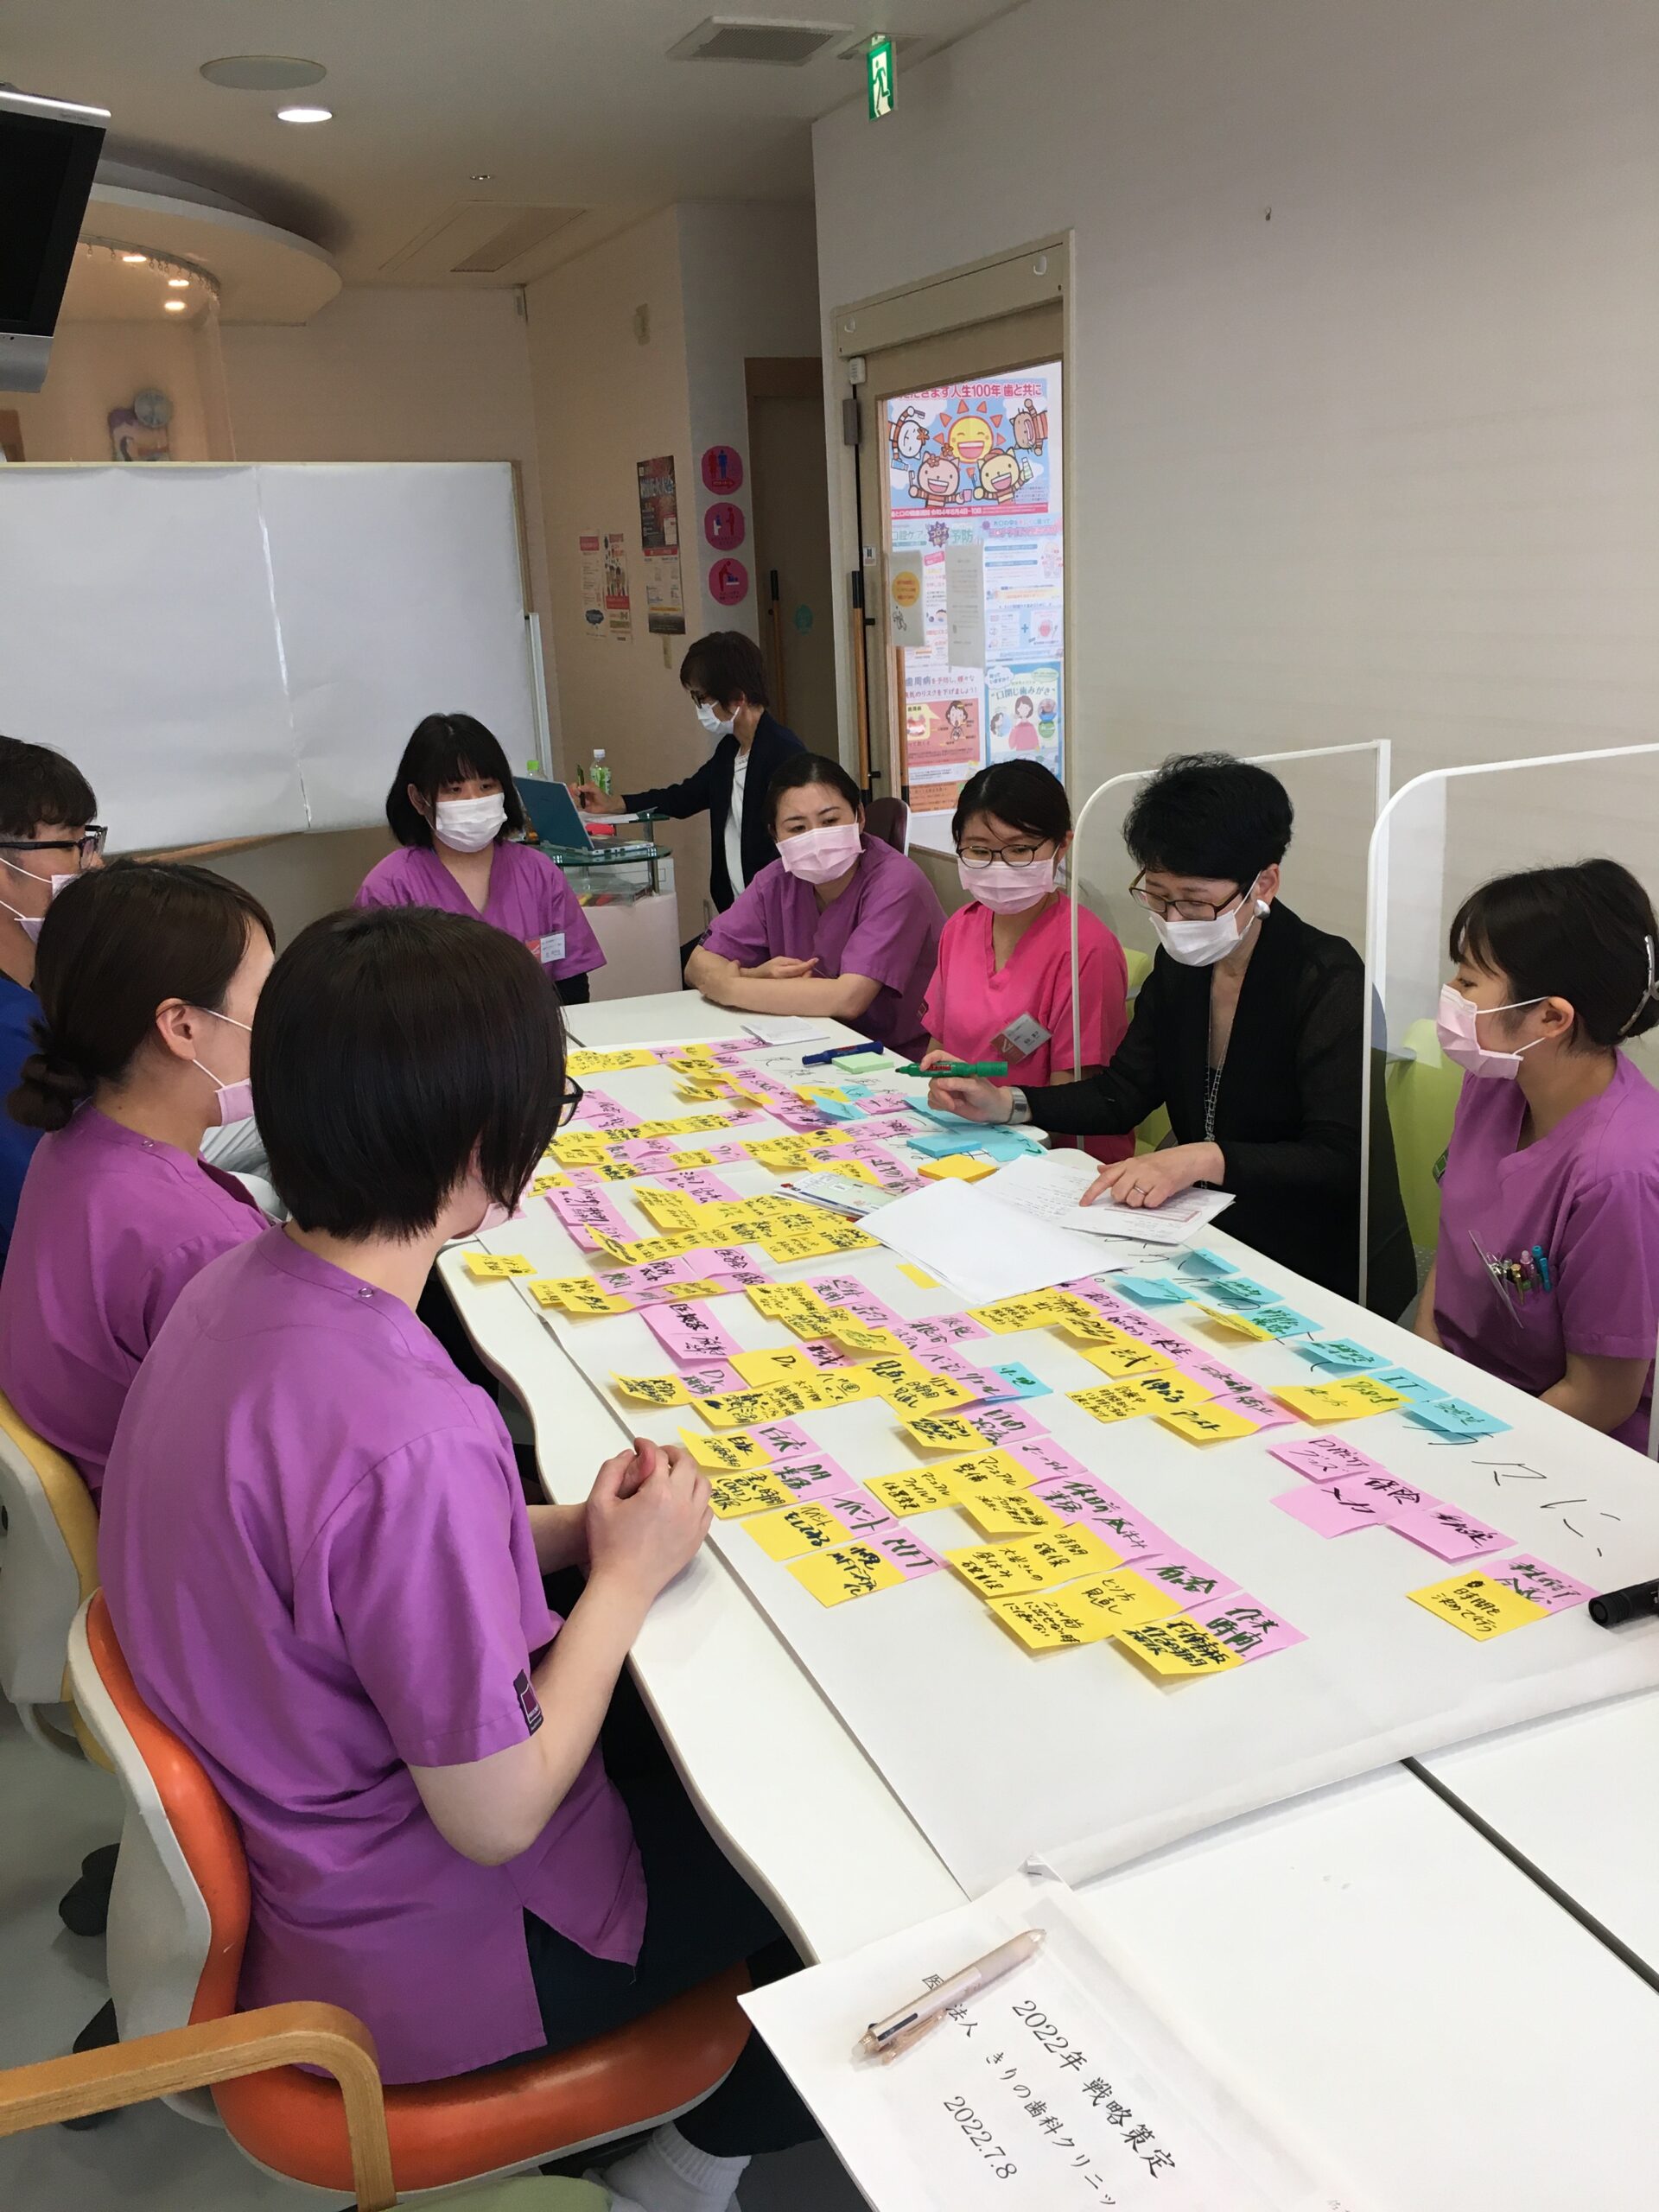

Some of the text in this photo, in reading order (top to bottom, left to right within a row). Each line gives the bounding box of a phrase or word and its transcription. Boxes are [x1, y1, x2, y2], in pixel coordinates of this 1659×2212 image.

[1004, 384, 1042, 397] 歯と共に
[1363, 1477, 1421, 1504] 保険
[1033, 1541, 1071, 1567] 確保
[1053, 1533, 1089, 1555] 時間
[1452, 1587, 1500, 1616] 時間を
[921, 1973, 981, 2038] 医法人
[1012, 1999, 1177, 2179] 2022年 戦略策定
[943, 2094, 1018, 2180] 2022.7.8
